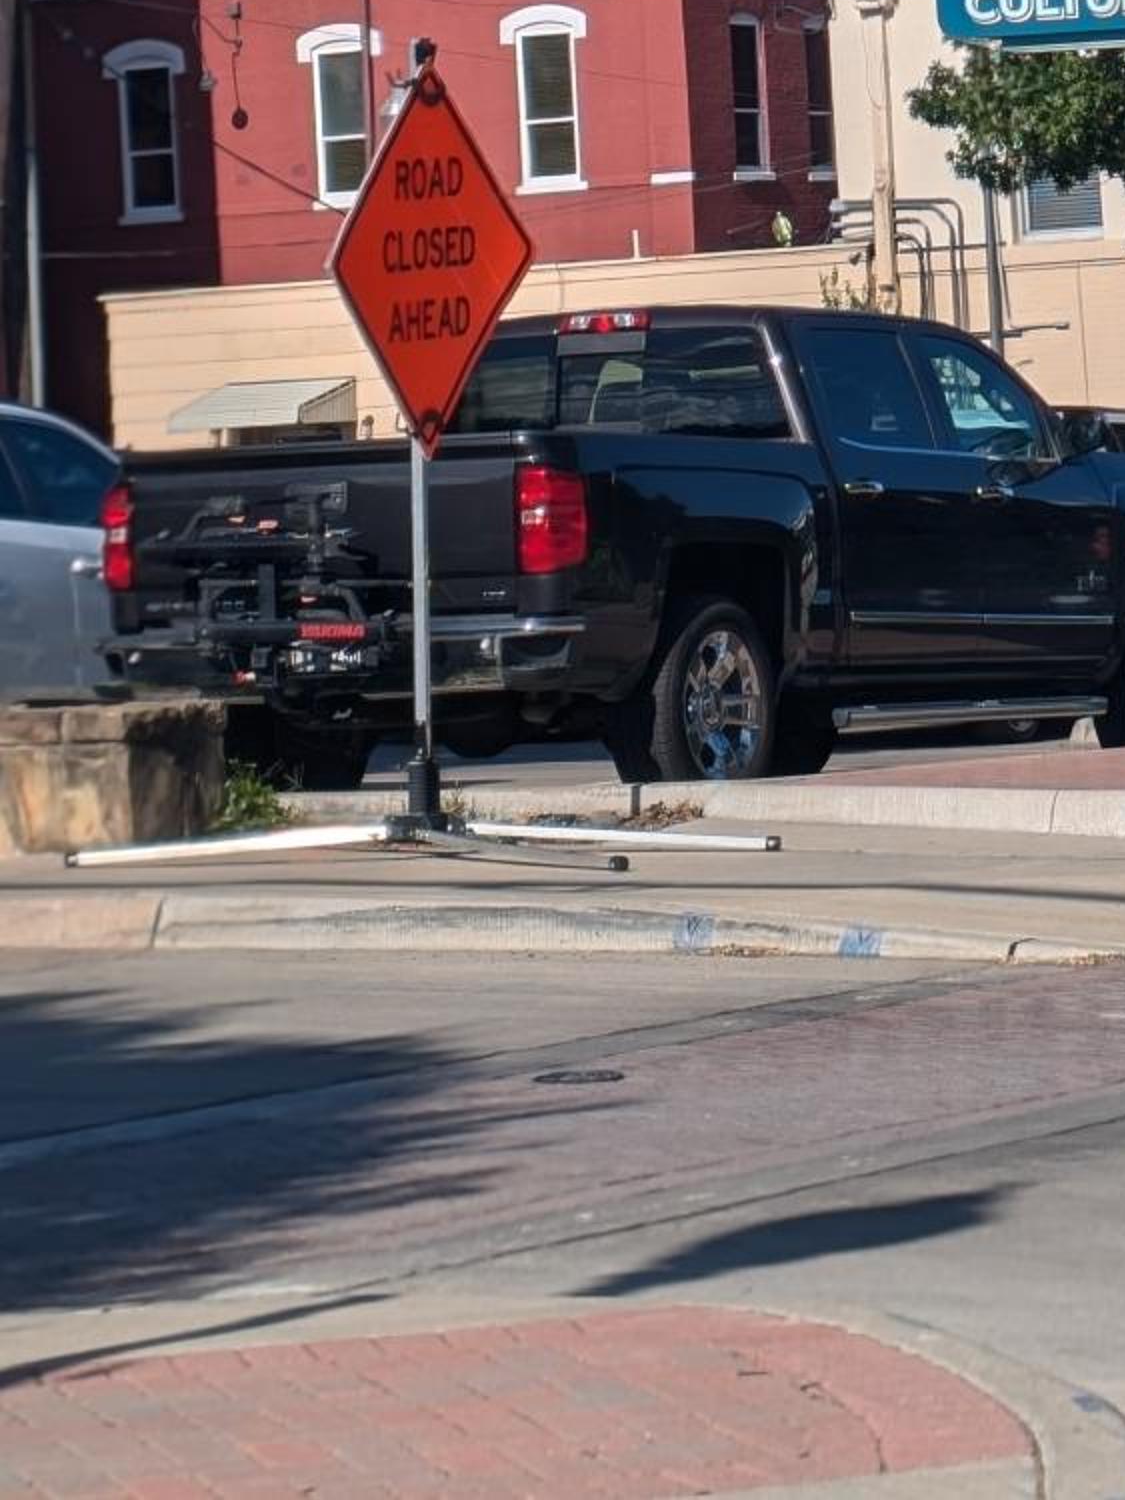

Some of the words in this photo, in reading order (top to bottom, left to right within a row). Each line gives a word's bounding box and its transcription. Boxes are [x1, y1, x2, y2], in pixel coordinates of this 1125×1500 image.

[395, 157, 462, 199] ROAD
[384, 227, 475, 272] CLOSED
[389, 297, 470, 343] AHEAD
